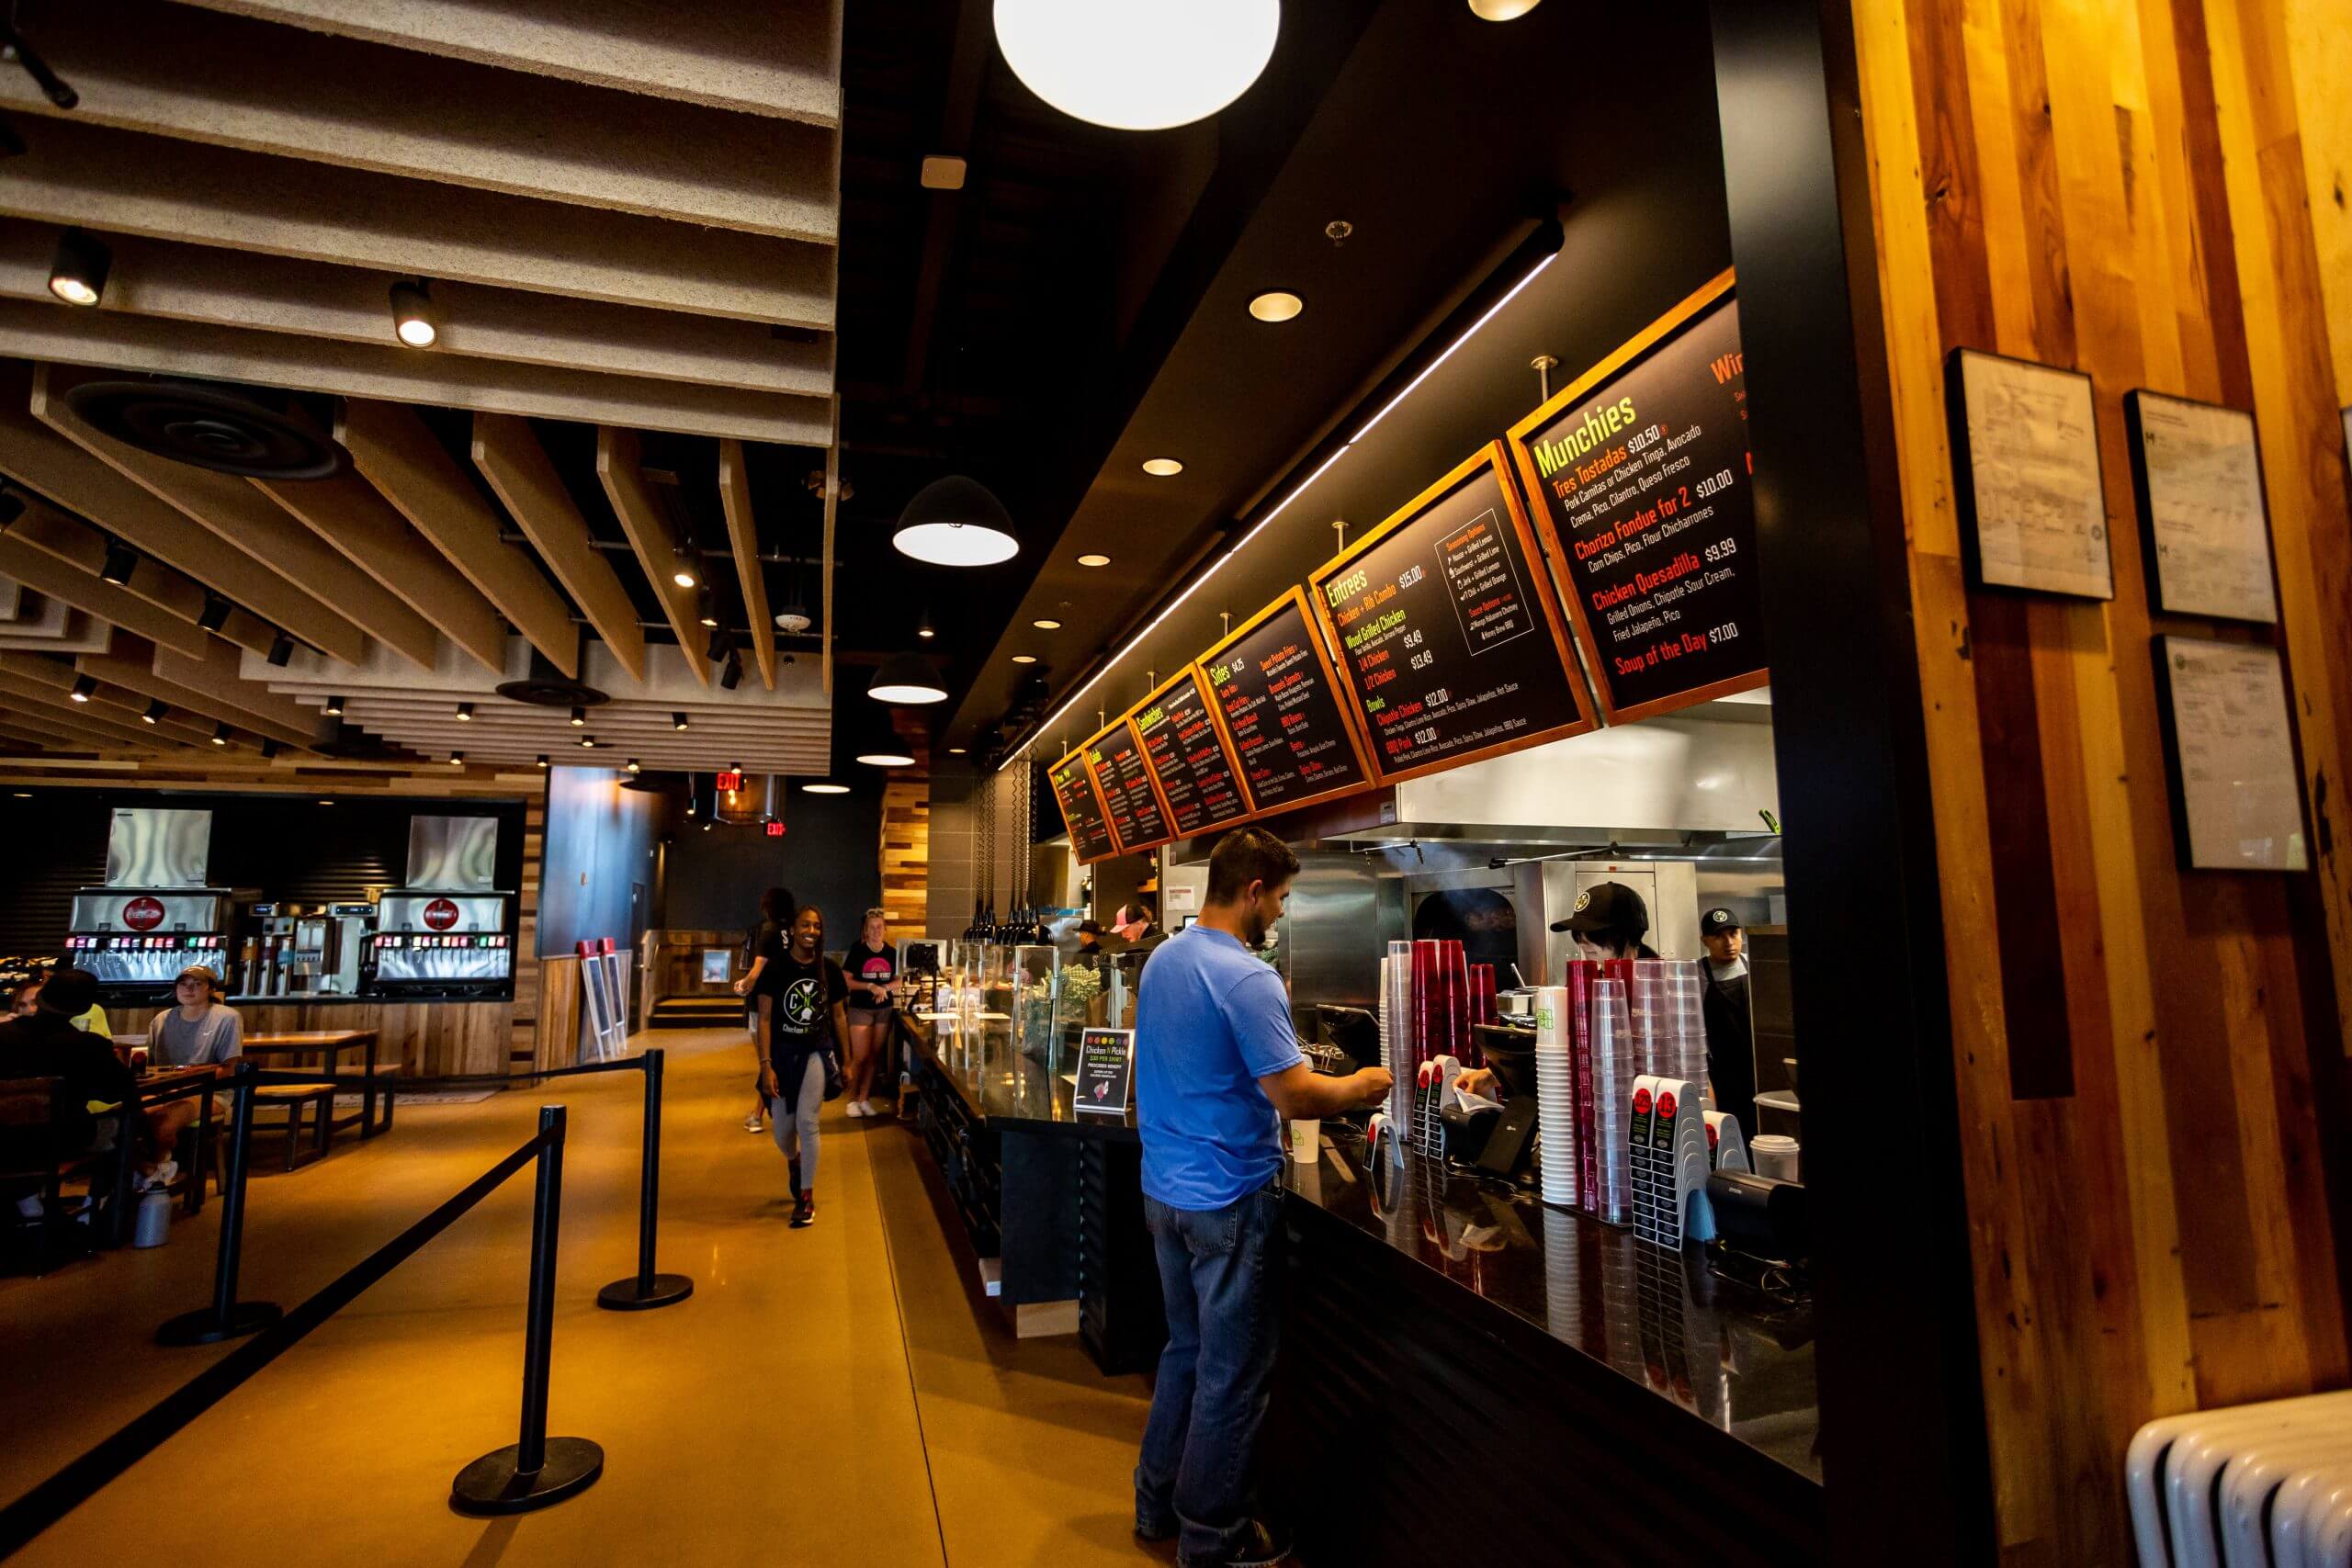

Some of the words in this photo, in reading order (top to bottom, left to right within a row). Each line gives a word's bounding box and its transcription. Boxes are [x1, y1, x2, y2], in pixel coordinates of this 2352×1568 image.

[1533, 397, 1635, 479] Munchies
[1552, 478, 1577, 498] Tres
[1575, 446, 1627, 484] Tostadas
[1628, 424, 1660, 454] $10.50
[1564, 494, 1580, 511] Pork
[1606, 476, 1614, 487] or
[1613, 459, 1643, 482] Chicken
[1642, 447, 1667, 465] Tinga,
[1667, 424, 1701, 452] Avocado
[1570, 511, 1594, 528] Crema,
[1591, 502, 1611, 516] Pico,
[1609, 486, 1639, 506] Cilantro,
[1638, 471, 1663, 491] Queso
[1662, 456, 1690, 477] Fresco
[1575, 531, 1615, 559] Chorizo
[1614, 510, 1657, 539] Fondue
[1657, 498, 1677, 517] for
[1678, 486, 1690, 507] 2
[1696, 469, 1733, 498] $10.00
[1588, 559, 1604, 573] Corn
[1603, 550, 1626, 566] Chips,
[1623, 541, 1644, 555] Pico,
[1642, 531, 1661, 547] Flour
[1661, 506, 1713, 537] Chicharrones
[1325, 570, 1367, 608] Entrees
[1592, 583, 1635, 610] Chicken
[1635, 553, 1700, 593] Quesadilla
[1705, 537, 1736, 562] $9.99
[1337, 607, 1360, 626] Chicken
[1363, 594, 1375, 611] Rib
[1374, 584, 1396, 604] Combo
[1398, 565, 1422, 589] $15.00
[1607, 607, 1629, 625] Grilled
[1654, 585, 1685, 605] Chipotle
[1684, 579, 1704, 593] Sour
[1703, 568, 1735, 585] Cream,
[1345, 630, 1363, 649] Wood
[1361, 619, 1381, 640] Grilled
[1379, 610, 1406, 630] Chicken
[1612, 626, 1631, 642] Fried
[1662, 610, 1680, 623] Pico
[1367, 650, 1389, 667] Chicken
[1404, 629, 1422, 649] $9.49
[1373, 669, 1396, 685] Chicken
[1410, 649, 1433, 670] $13.49
[1615, 656, 1645, 675] Soup
[1645, 645, 1658, 665] of
[1659, 642, 1681, 660] the
[1680, 633, 1707, 652] Day
[1709, 622, 1738, 643] $7.00
[1210, 664, 1230, 686] Sides
[1365, 695, 1385, 713] Bowls
[1398, 702, 1422, 717] Chicken
[1425, 688, 1448, 707] $12.00
[1415, 727, 1437, 744] $12.00
[717, 773, 741, 790] EXIT
[767, 823, 783, 836] EXIT
[790, 994, 797, 1009] C
[1086, 1045, 1106, 1055] Chicken
[1112, 1046, 1126, 1056] Pickle
